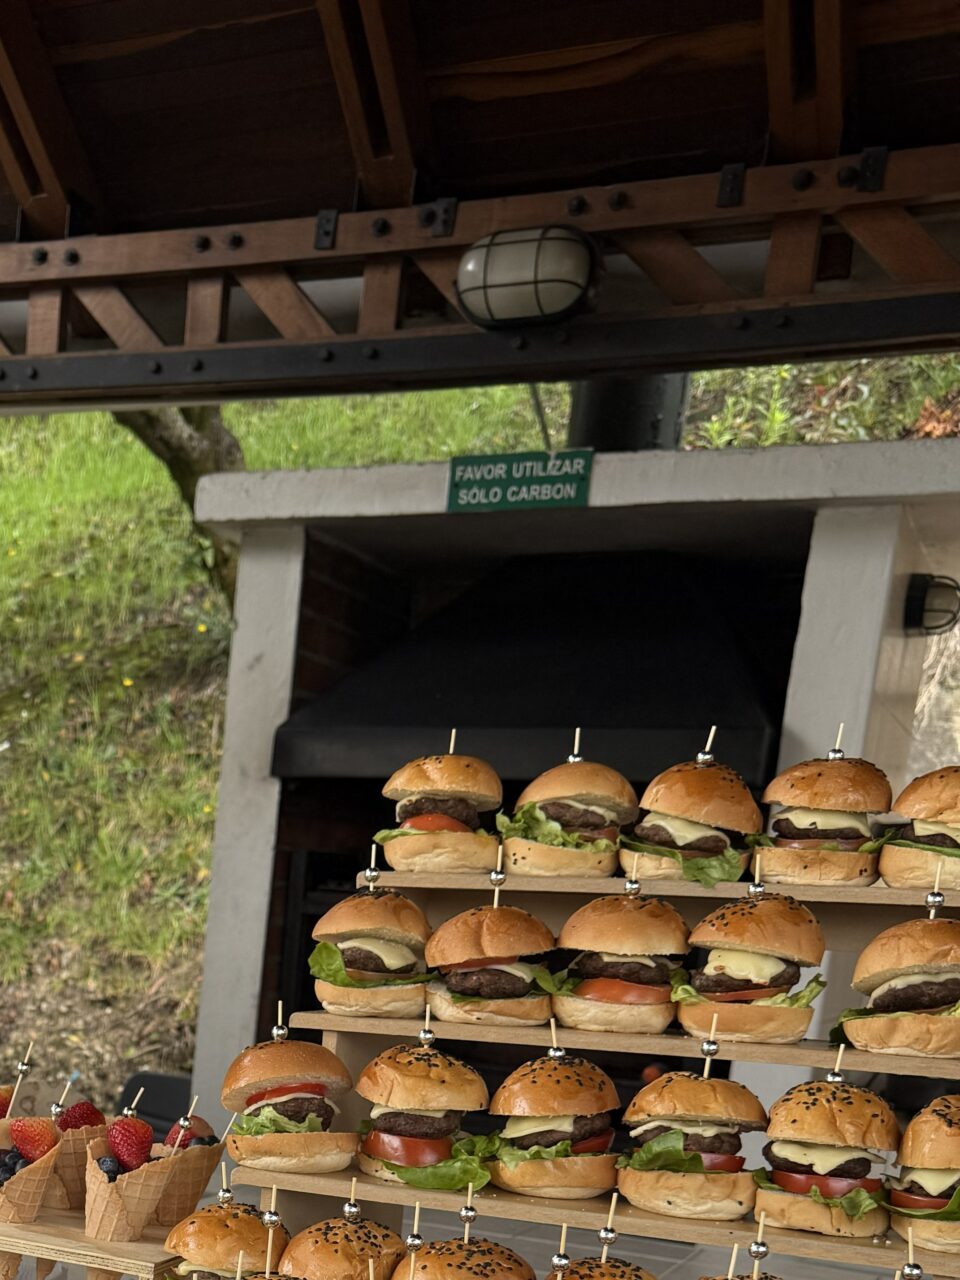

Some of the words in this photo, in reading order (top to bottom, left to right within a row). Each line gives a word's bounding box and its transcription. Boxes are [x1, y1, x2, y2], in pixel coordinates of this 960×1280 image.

[454, 461, 507, 482] FAVOR
[512, 458, 586, 479] UTILIZAR
[506, 482, 578, 502] CARBON
